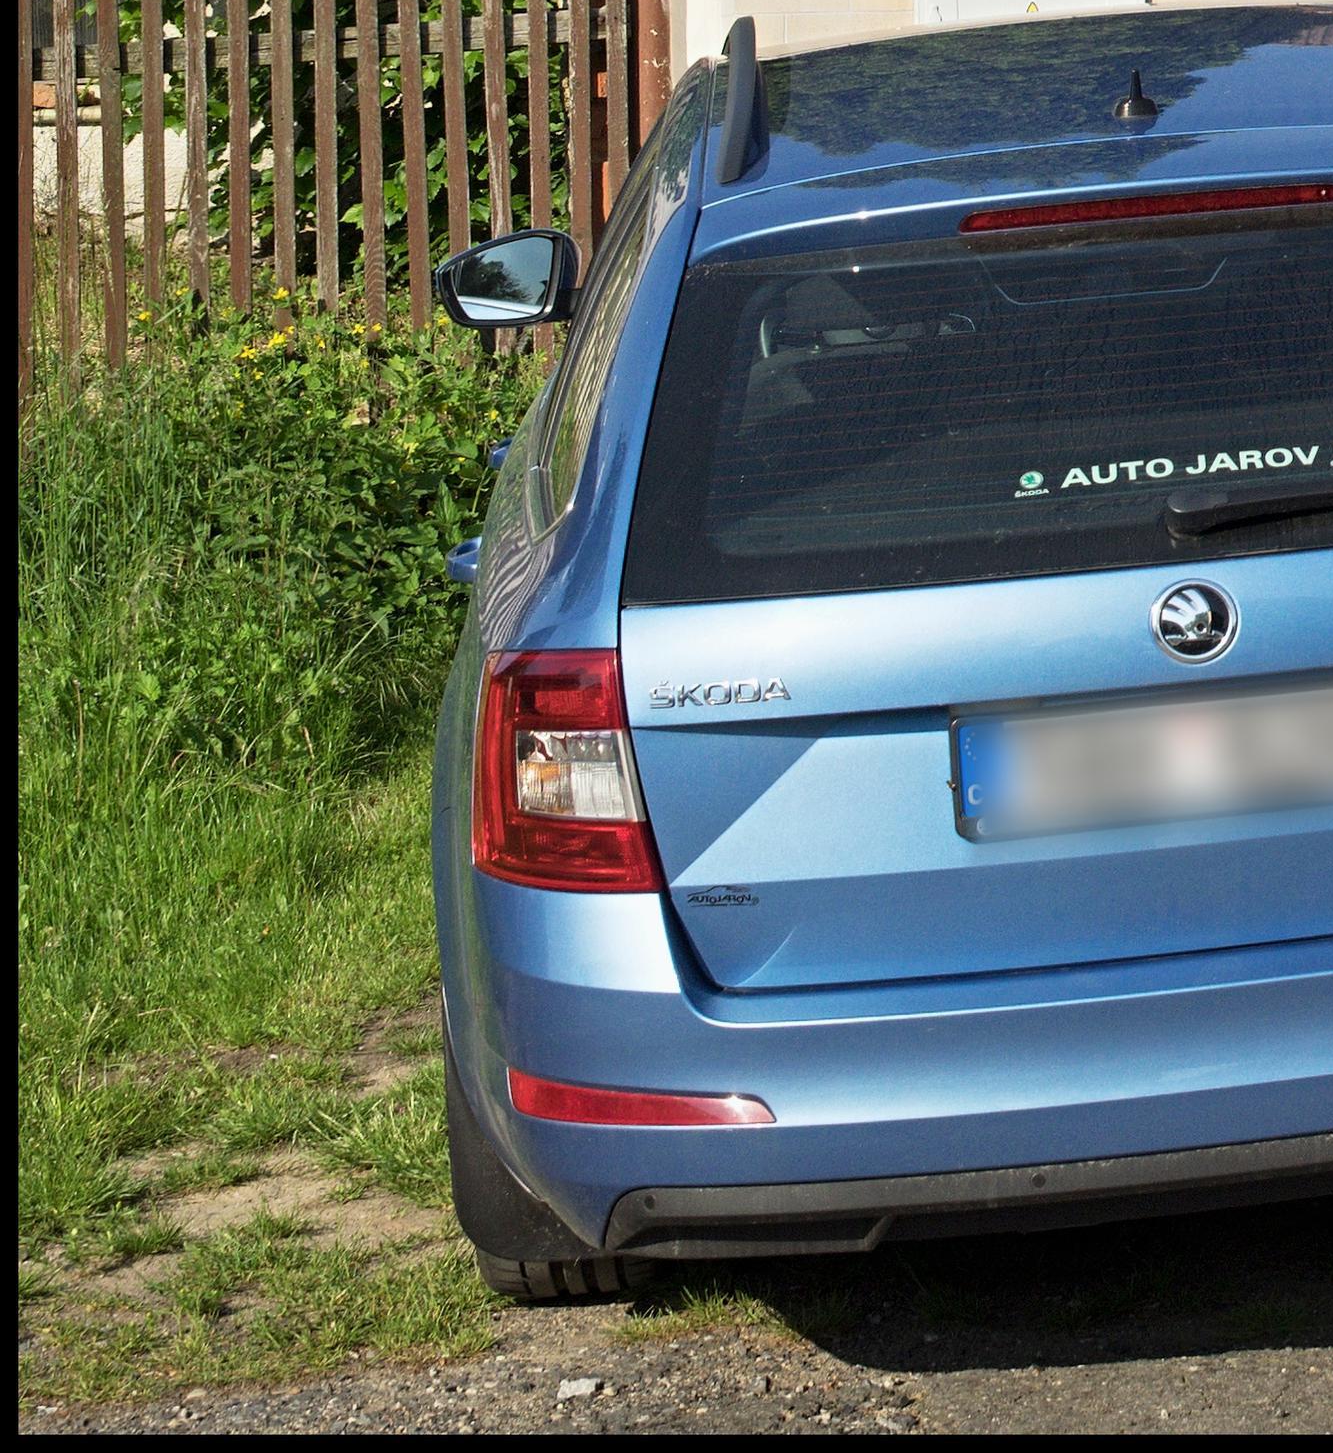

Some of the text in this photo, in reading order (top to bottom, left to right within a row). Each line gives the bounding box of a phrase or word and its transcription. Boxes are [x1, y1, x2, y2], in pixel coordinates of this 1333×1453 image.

[1060, 445, 1320, 489] AUTO JAROV
[1014, 487, 1050, 499] ŠKODA
[649, 677, 792, 710] ŠKODA
